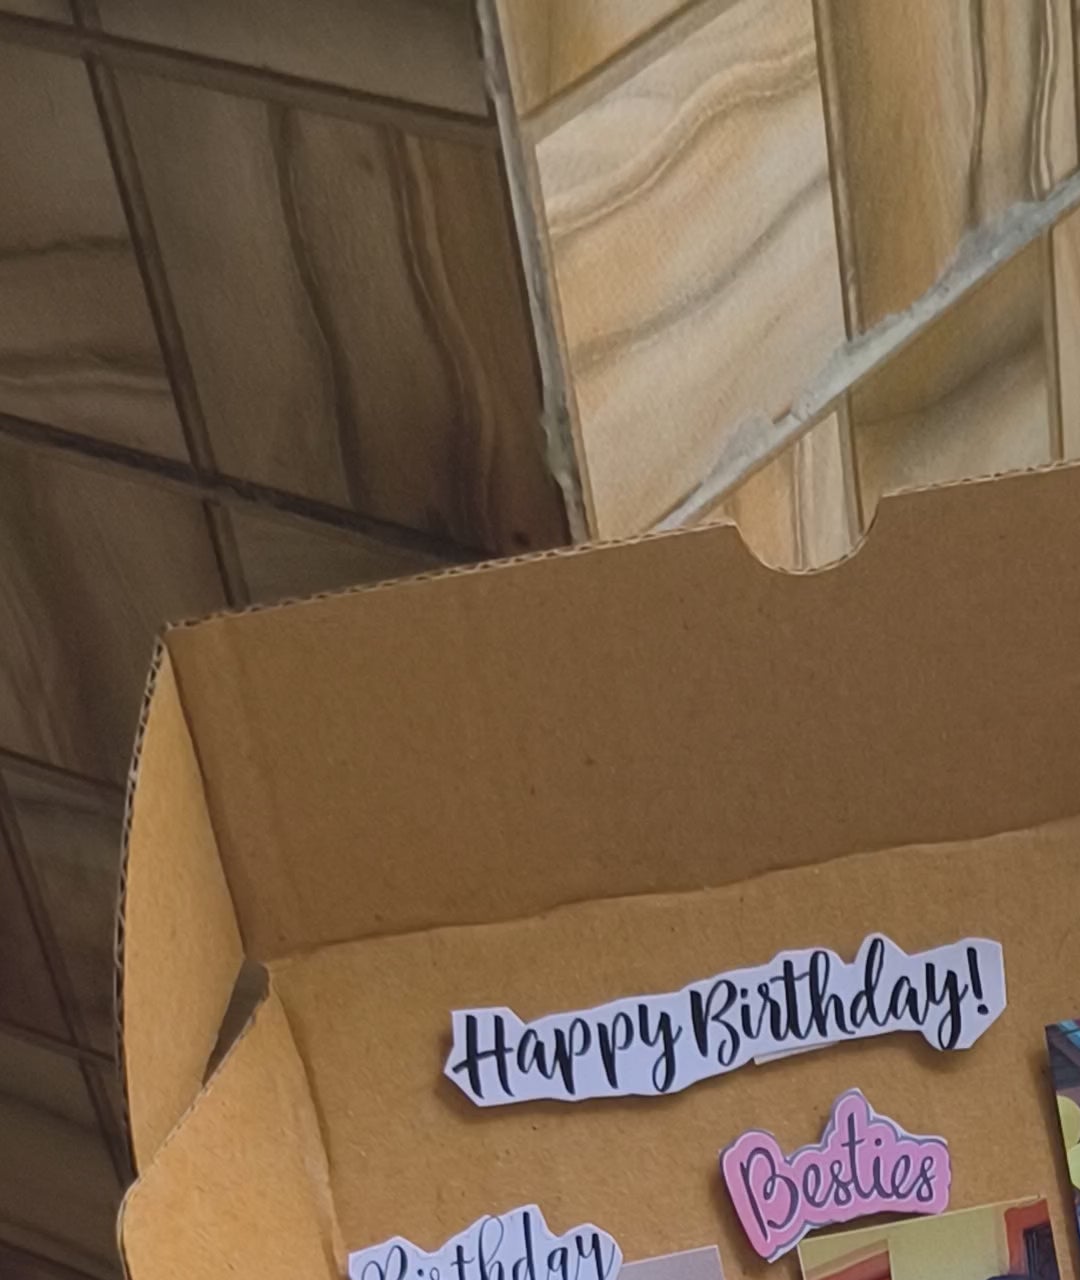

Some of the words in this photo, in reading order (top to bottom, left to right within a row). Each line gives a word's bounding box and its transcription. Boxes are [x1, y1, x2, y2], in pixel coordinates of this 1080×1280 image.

[452, 1003, 683, 1099] Happy
[689, 938, 989, 1066] Birthday!
[740, 1112, 935, 1241] Besties
